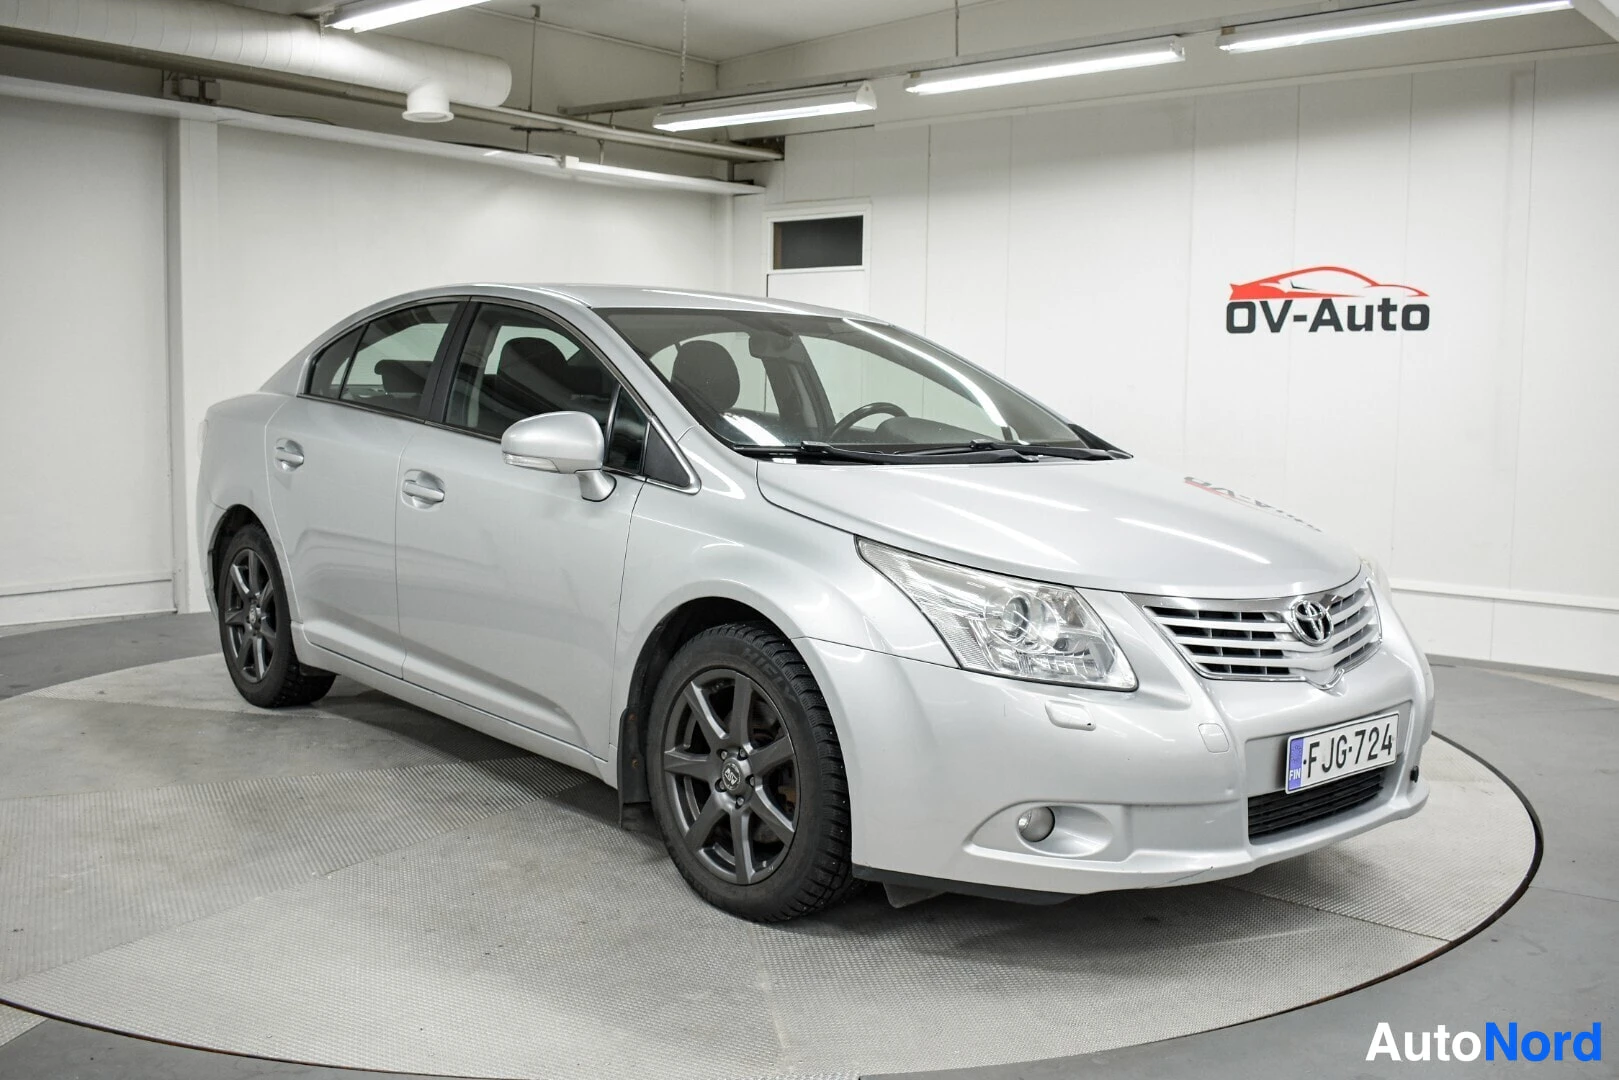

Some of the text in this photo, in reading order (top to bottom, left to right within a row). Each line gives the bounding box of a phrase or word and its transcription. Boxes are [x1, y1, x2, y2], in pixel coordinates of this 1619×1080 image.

[1226, 297, 1430, 334] OV-Auto
[1307, 723, 1392, 778] FJG-724
[1289, 768, 1301, 781] FIN
